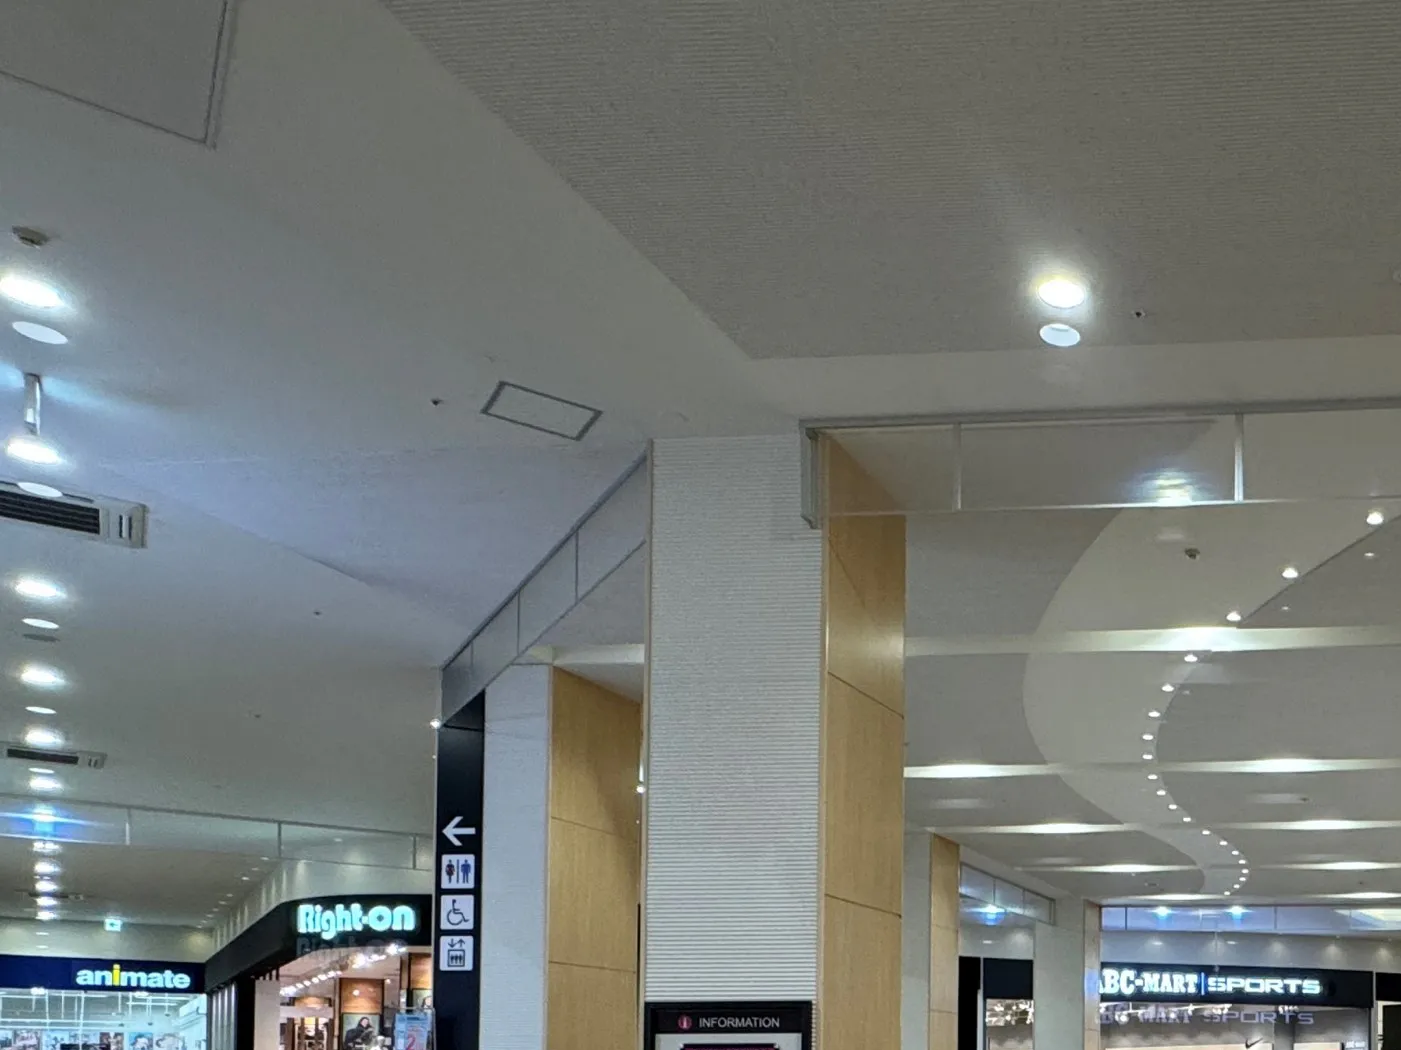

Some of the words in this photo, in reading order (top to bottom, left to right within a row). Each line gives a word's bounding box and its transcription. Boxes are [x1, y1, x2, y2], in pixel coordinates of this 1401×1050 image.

[297, 903, 415, 940] Right-on
[76, 964, 190, 988] animate
[1208, 977, 1321, 994] SPORTS
[699, 1016, 780, 1029] INFORMATION
